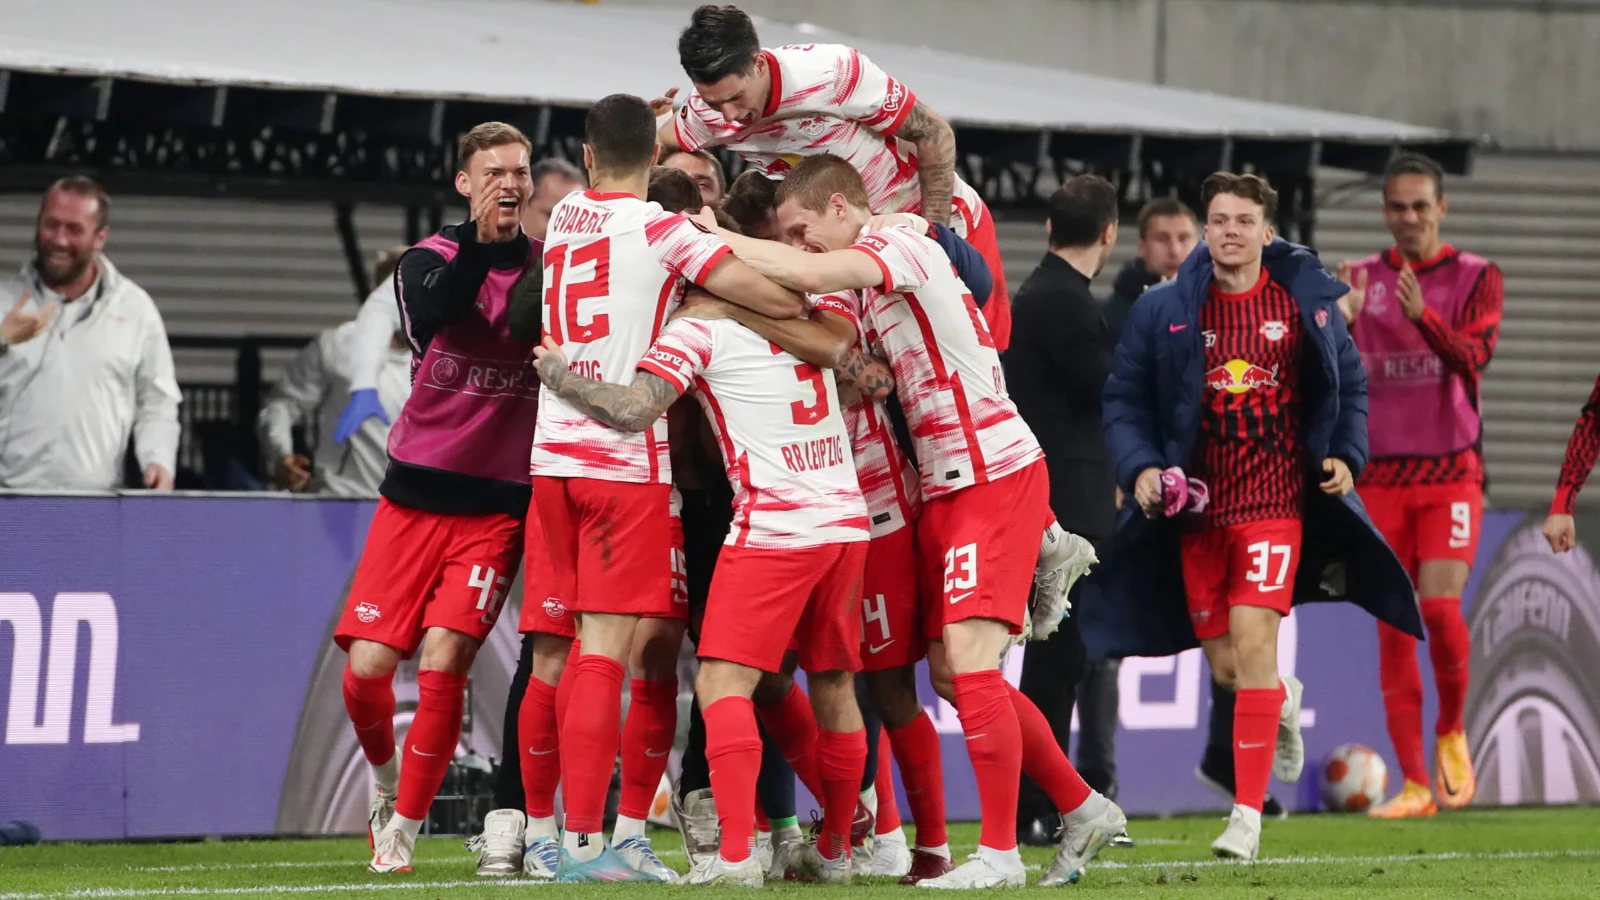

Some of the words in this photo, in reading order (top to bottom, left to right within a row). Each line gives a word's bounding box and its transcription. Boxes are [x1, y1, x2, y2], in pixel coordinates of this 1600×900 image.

[541, 236, 610, 347] 32
[646, 342, 684, 367] eganz
[1205, 333, 1217, 347] 37
[781, 443, 806, 473] RB
[805, 434, 843, 471] LEIPZIG
[1451, 502, 1470, 539] 9
[943, 542, 977, 593] 23
[1245, 540, 1291, 585] 37
[860, 593, 891, 643] 4
